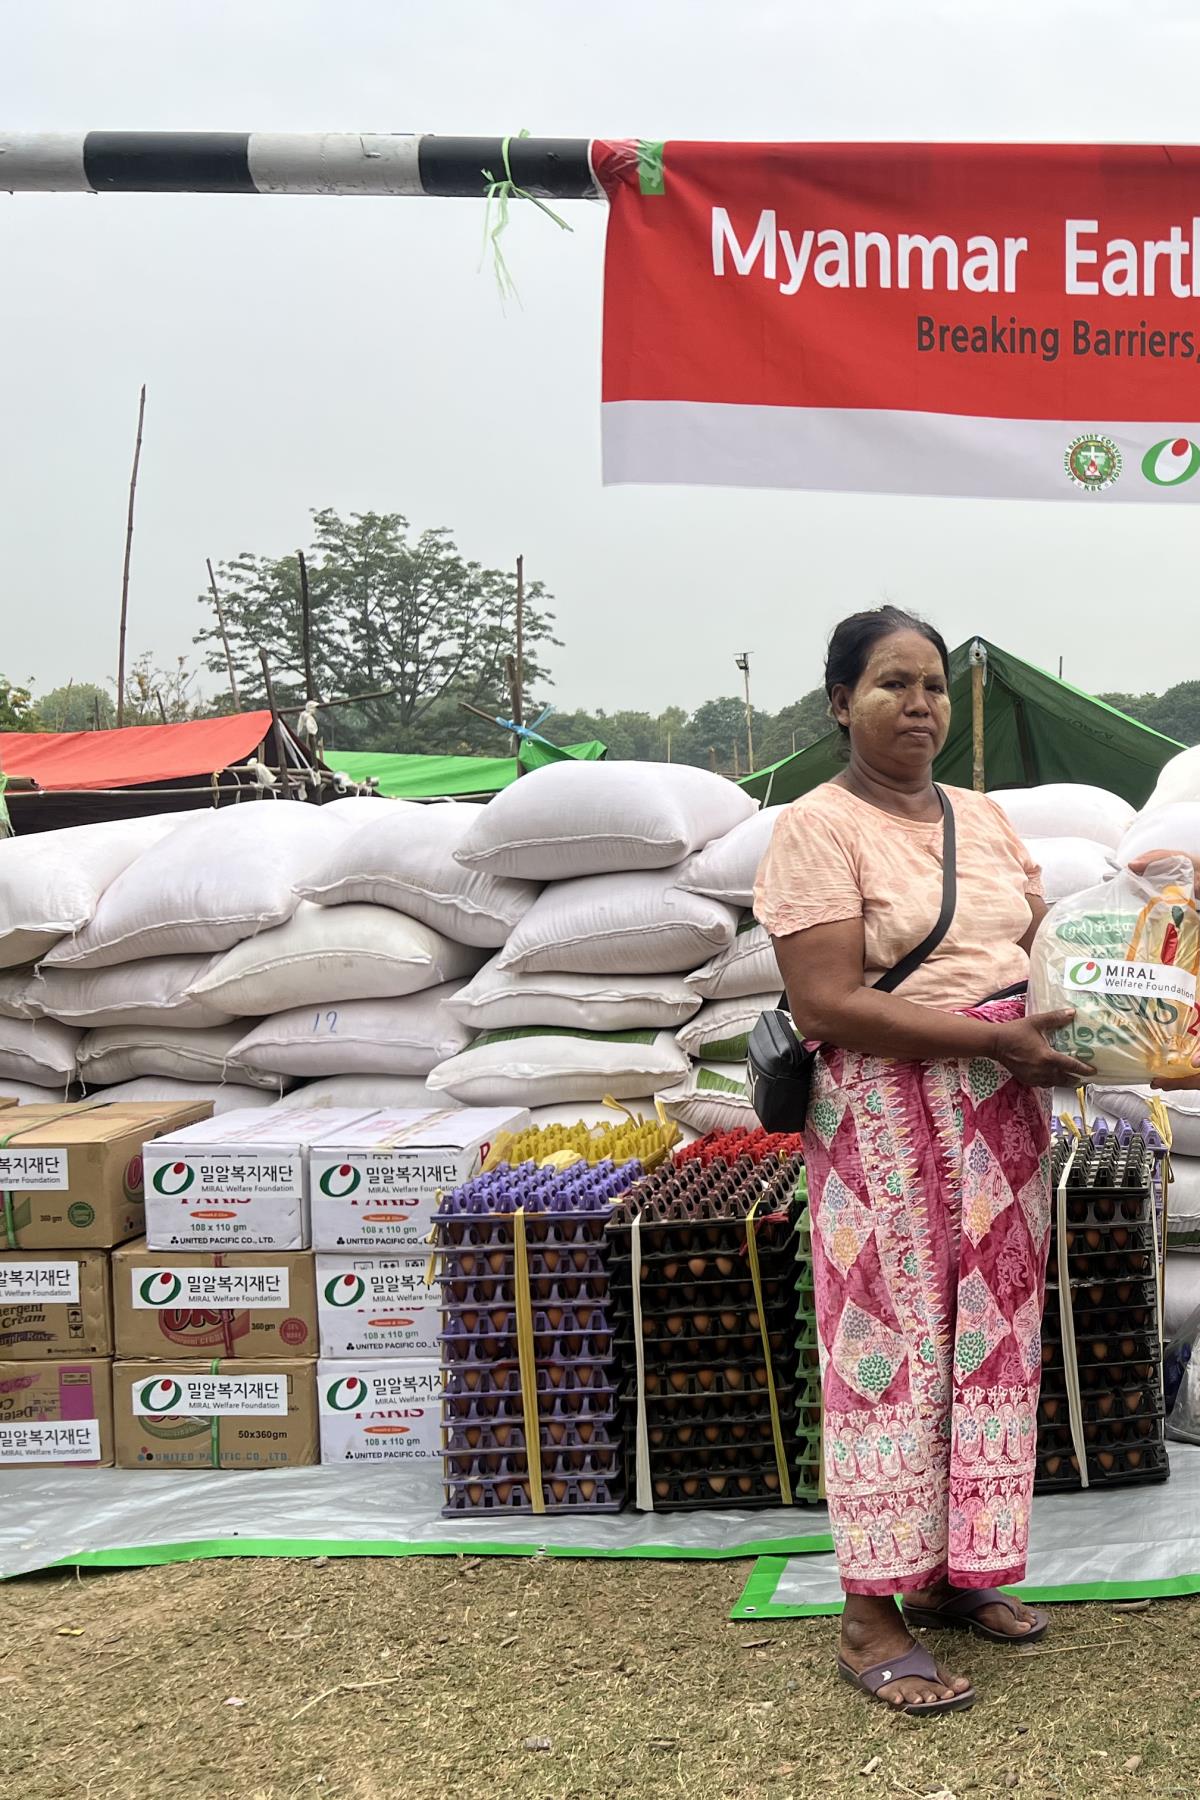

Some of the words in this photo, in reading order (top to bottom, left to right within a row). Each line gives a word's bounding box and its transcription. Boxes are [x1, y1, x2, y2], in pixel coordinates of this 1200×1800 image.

[711, 206, 1028, 296] Myanmar
[917, 315, 1059, 361] Breaking
[1084, 484, 1103, 492] KBC
[1105, 965, 1156, 981] MIRAL
[1105, 978, 1144, 990] Welfare
[1145, 981, 1194, 1000] Foundation
[201, 1165, 294, 1183] 밀알복지재단
[366, 1165, 458, 1184] 밀알복지재단
[21, 1176, 61, 1184] Foundation
[233, 1225, 247, 1233] gm
[362, 1226, 377, 1234] 108
[386, 1226, 401, 1234] 110
[403, 1227, 417, 1235] gm
[187, 1275, 281, 1293] 밀알복지재단
[32, 1289, 72, 1297] Foundation
[396, 1293, 423, 1301] Welfare
[241, 1294, 282, 1302] Foundation
[187, 1382, 280, 1400] 밀알복지재단
[399, 1396, 426, 1404] Welfare
[241, 1401, 281, 1409] Foundation
[0, 1428, 91, 1447] 밀알복지재단
[238, 1430, 288, 1440] 50x360gm
[25, 1448, 52, 1456] Welfare
[53, 1447, 92, 1456] Foundation
[155, 1453, 194, 1461] UNITED
